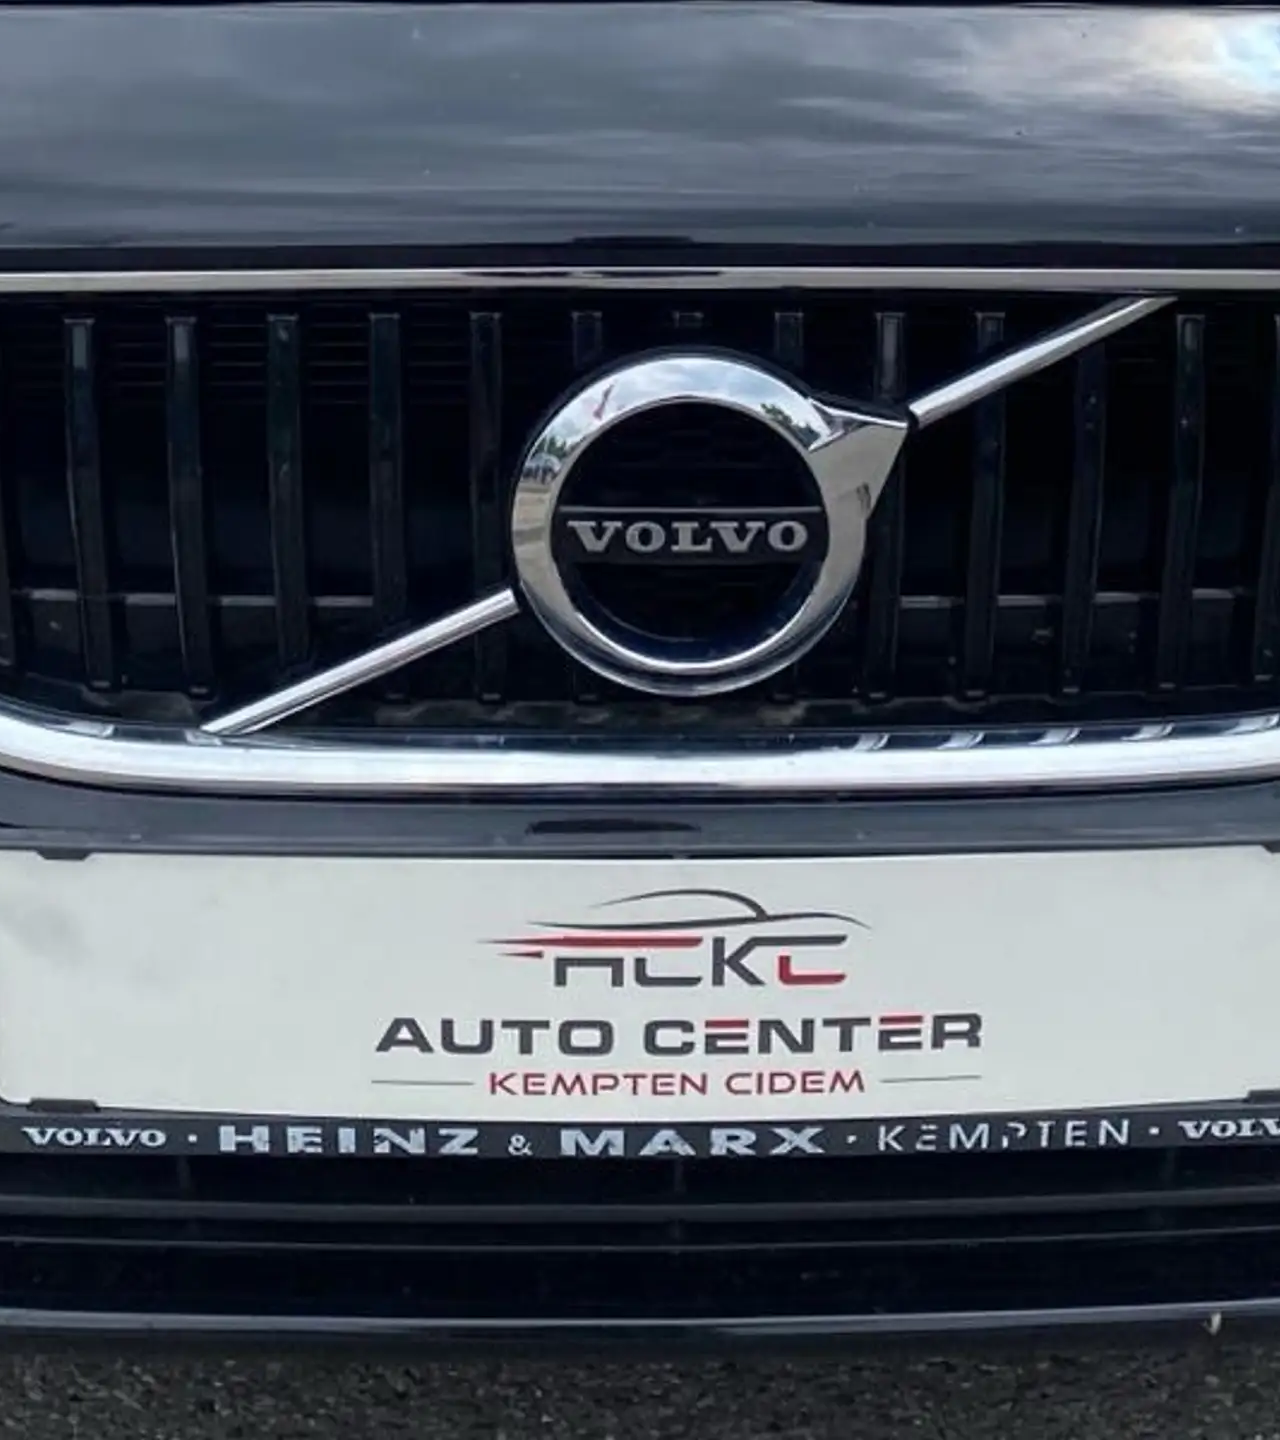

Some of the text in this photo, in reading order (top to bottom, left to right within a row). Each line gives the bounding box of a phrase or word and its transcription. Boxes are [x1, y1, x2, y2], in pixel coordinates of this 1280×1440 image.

[567, 520, 809, 553] VOLVO
[375, 1012, 983, 1057] AUTO CENTER
[489, 1069, 866, 1097] KEMPTEN CIDEM
[22, 1126, 168, 1148] VOLVO
[219, 1125, 479, 1155] HEINZ
[507, 1134, 533, 1157] &
[560, 1127, 826, 1157] MARX
[876, 1118, 1131, 1152] KEMPTEN
